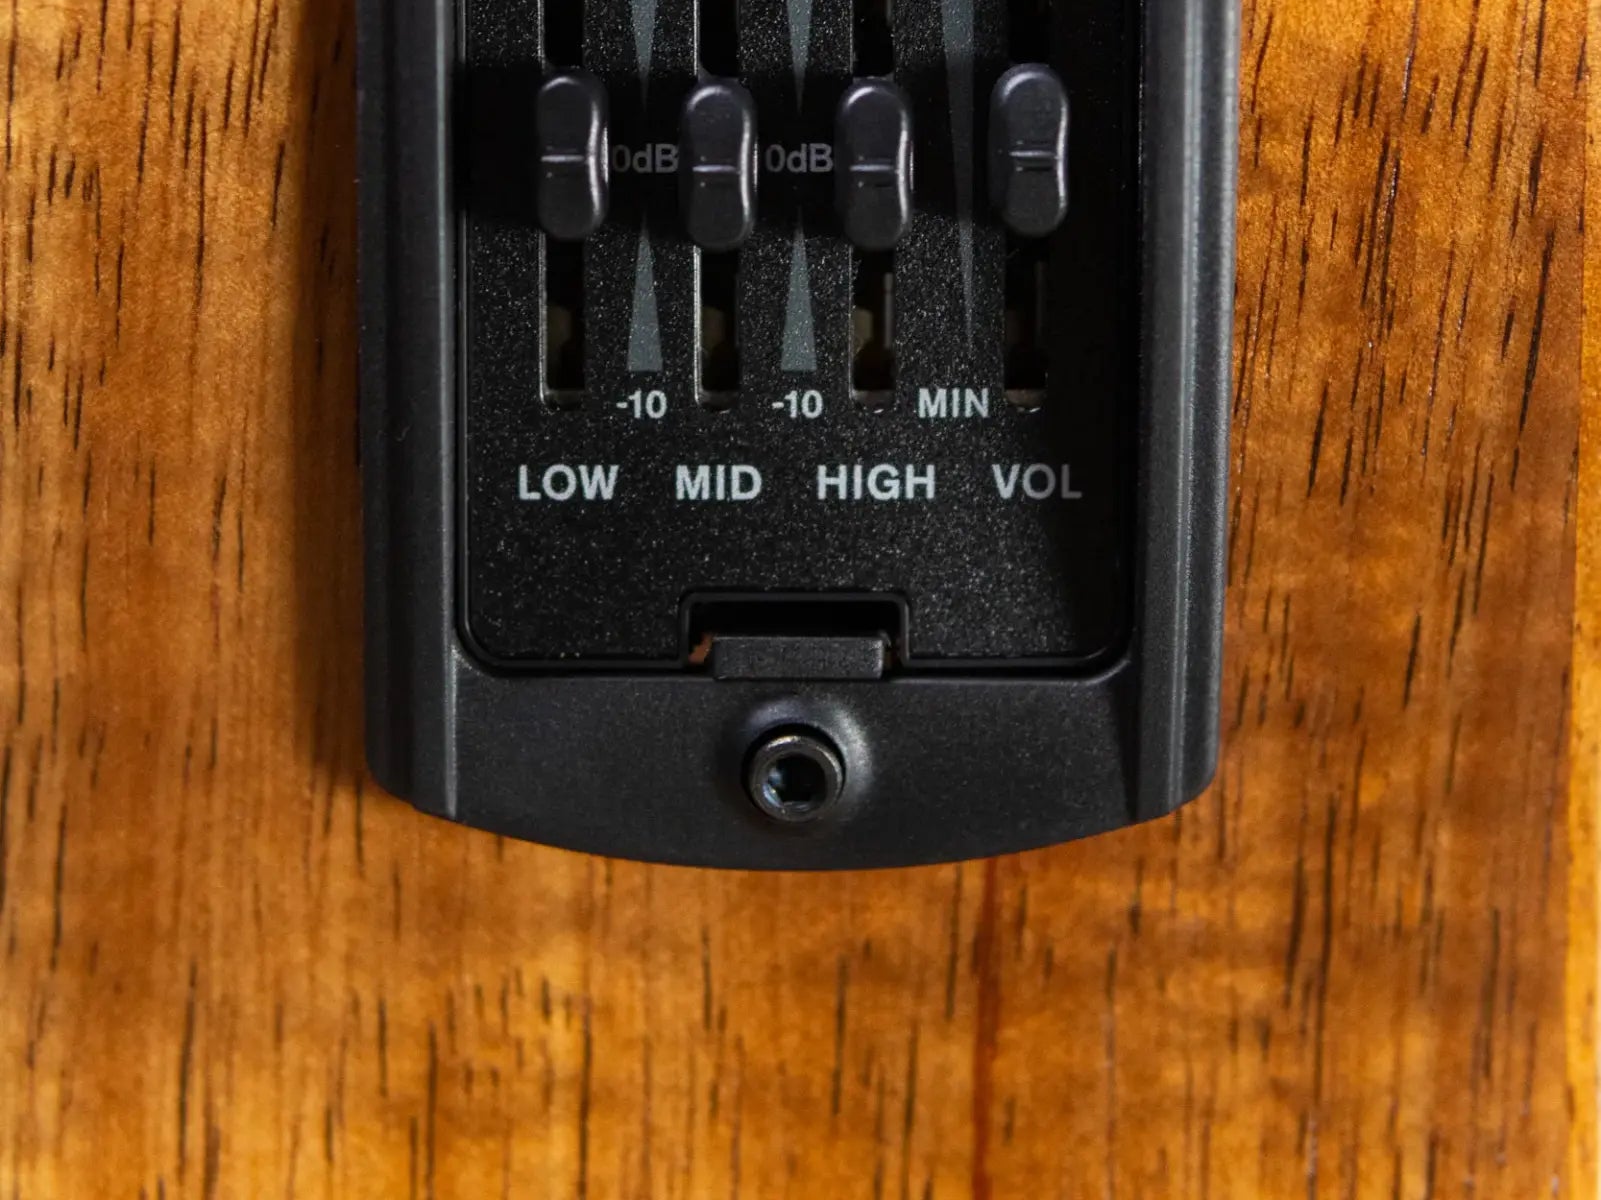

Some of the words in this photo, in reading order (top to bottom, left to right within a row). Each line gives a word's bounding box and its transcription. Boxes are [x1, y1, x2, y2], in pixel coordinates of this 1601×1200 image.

[612, 143, 680, 174] 0dB
[766, 143, 834, 174] 0dB
[615, 390, 667, 419] -10
[771, 390, 823, 419] -10
[917, 388, 990, 418] MIN
[518, 464, 618, 501] LOW
[675, 464, 762, 500] MID
[817, 464, 936, 501] HIGH
[993, 464, 1082, 500] VOL
